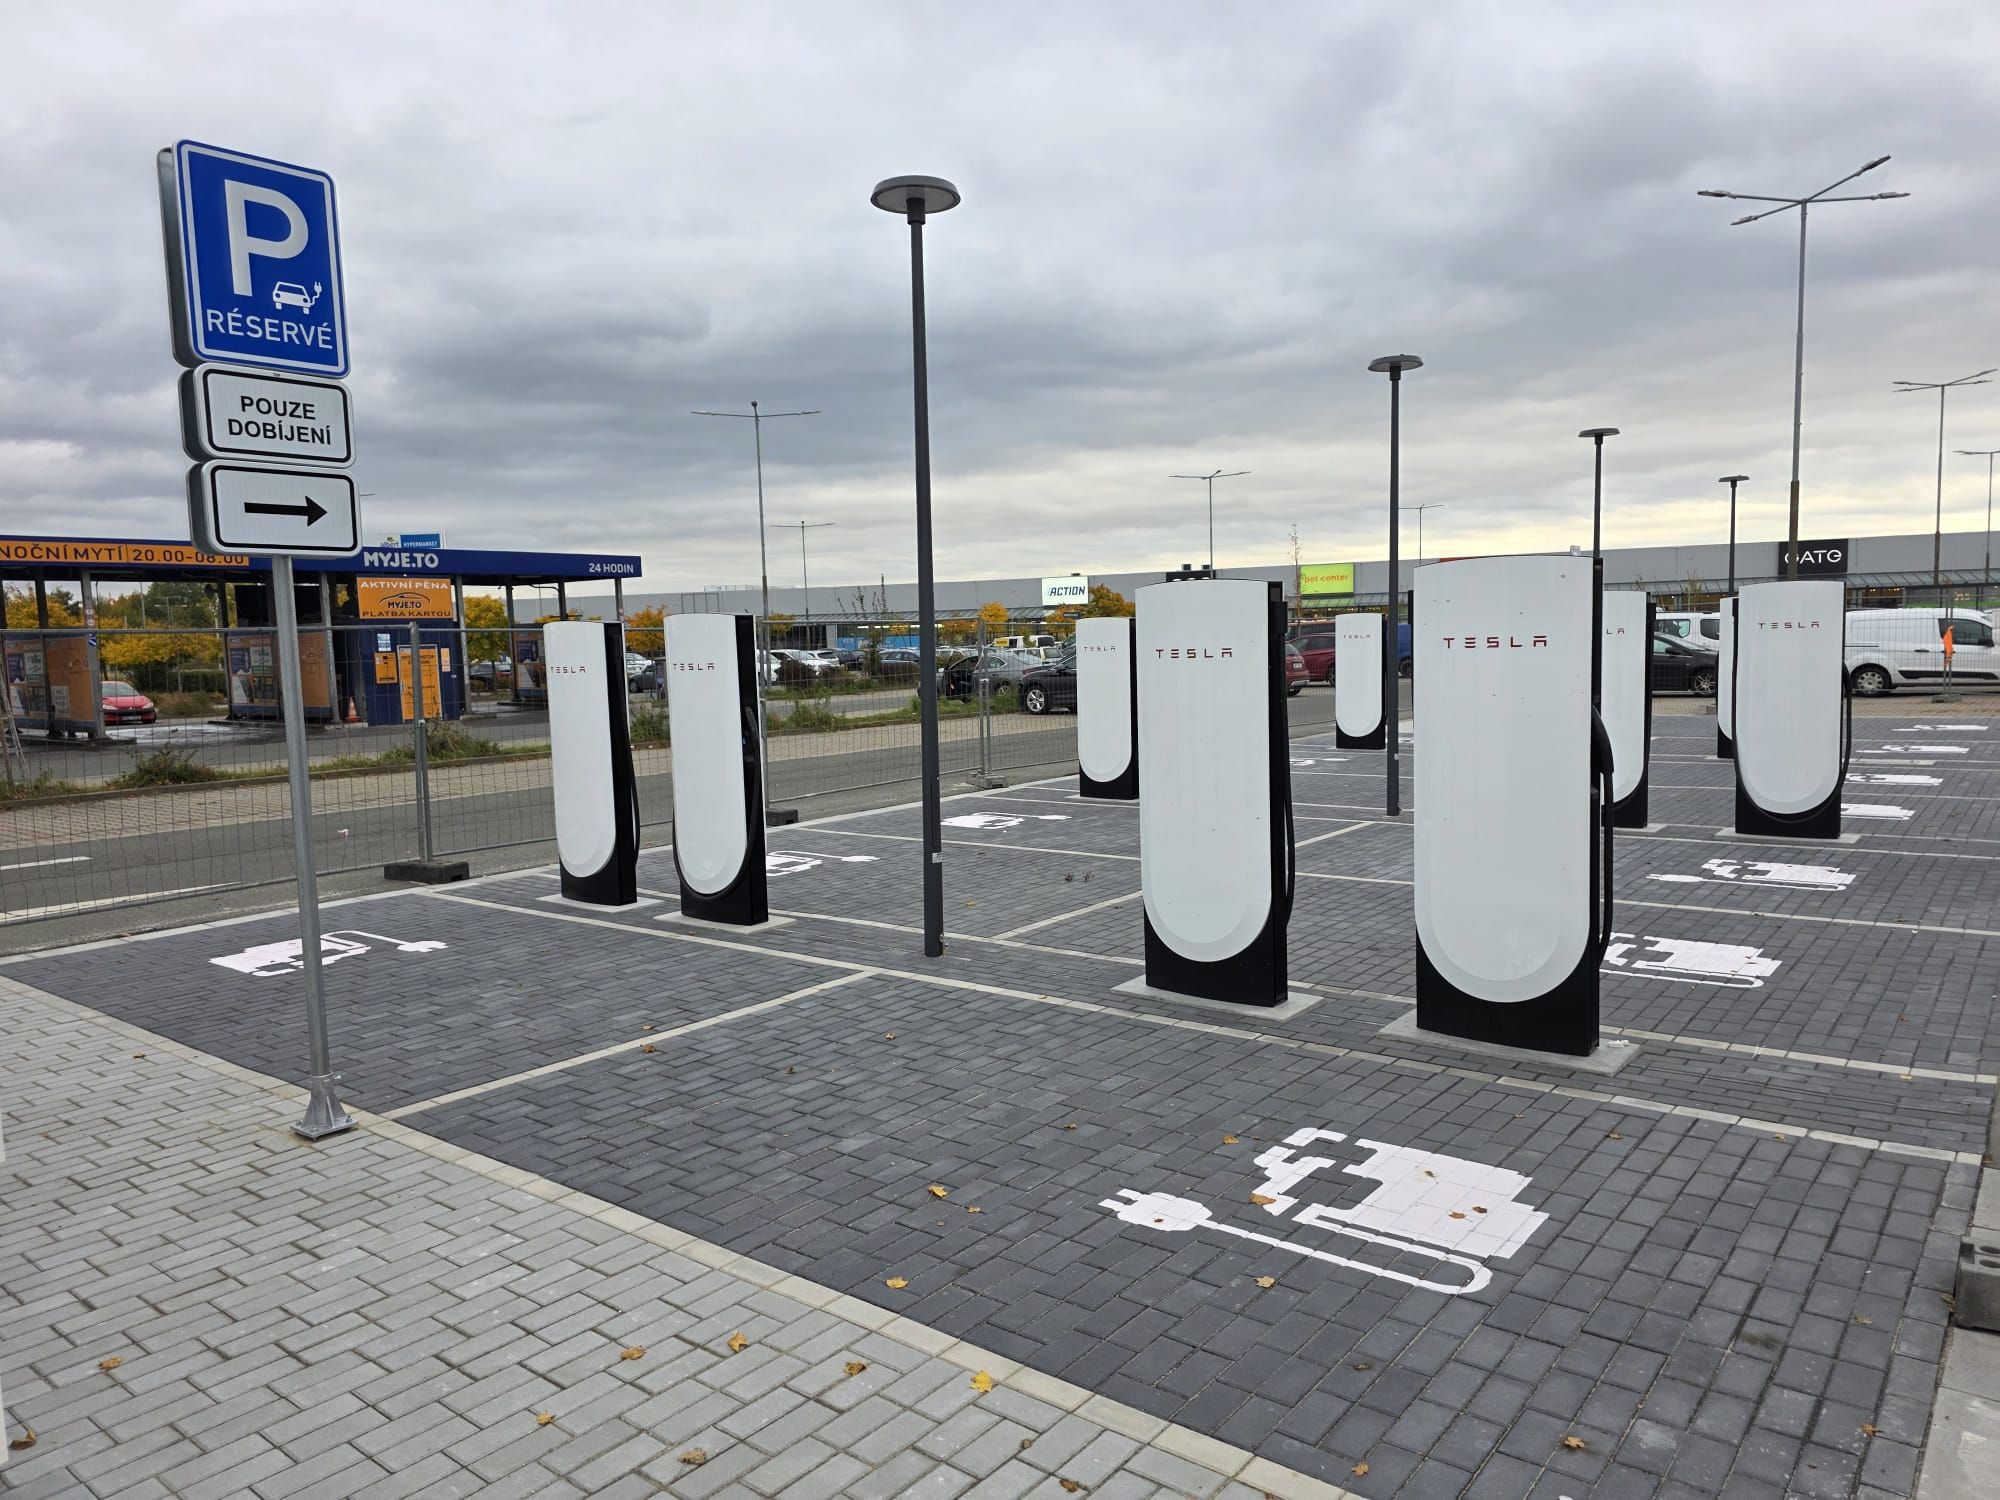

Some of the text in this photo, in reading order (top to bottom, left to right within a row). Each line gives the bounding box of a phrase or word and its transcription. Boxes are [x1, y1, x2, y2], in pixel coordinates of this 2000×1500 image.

[224, 179, 308, 296] P
[206, 308, 333, 349] RÉSERVÉ
[240, 395, 316, 420] POUZE
[228, 418, 331, 446] DOBÍJENÍ
[0, 543, 68, 560] NOČNÍ
[73, 545, 122, 561] MYTÍ
[363, 552, 439, 568] MYJE.TO
[589, 563, 634, 574] 24 HODIN
[361, 581, 412, 589] AKTIVNÍ
[1305, 574, 1348, 584] pet center
[1050, 586, 1085, 596] ACTION
[1758, 621, 1820, 630] TESLA
[1443, 635, 1547, 649] TESLA
[1156, 647, 1233, 659] TESLA
[551, 666, 586, 674] TESLA
[673, 663, 715, 671] TESLA
